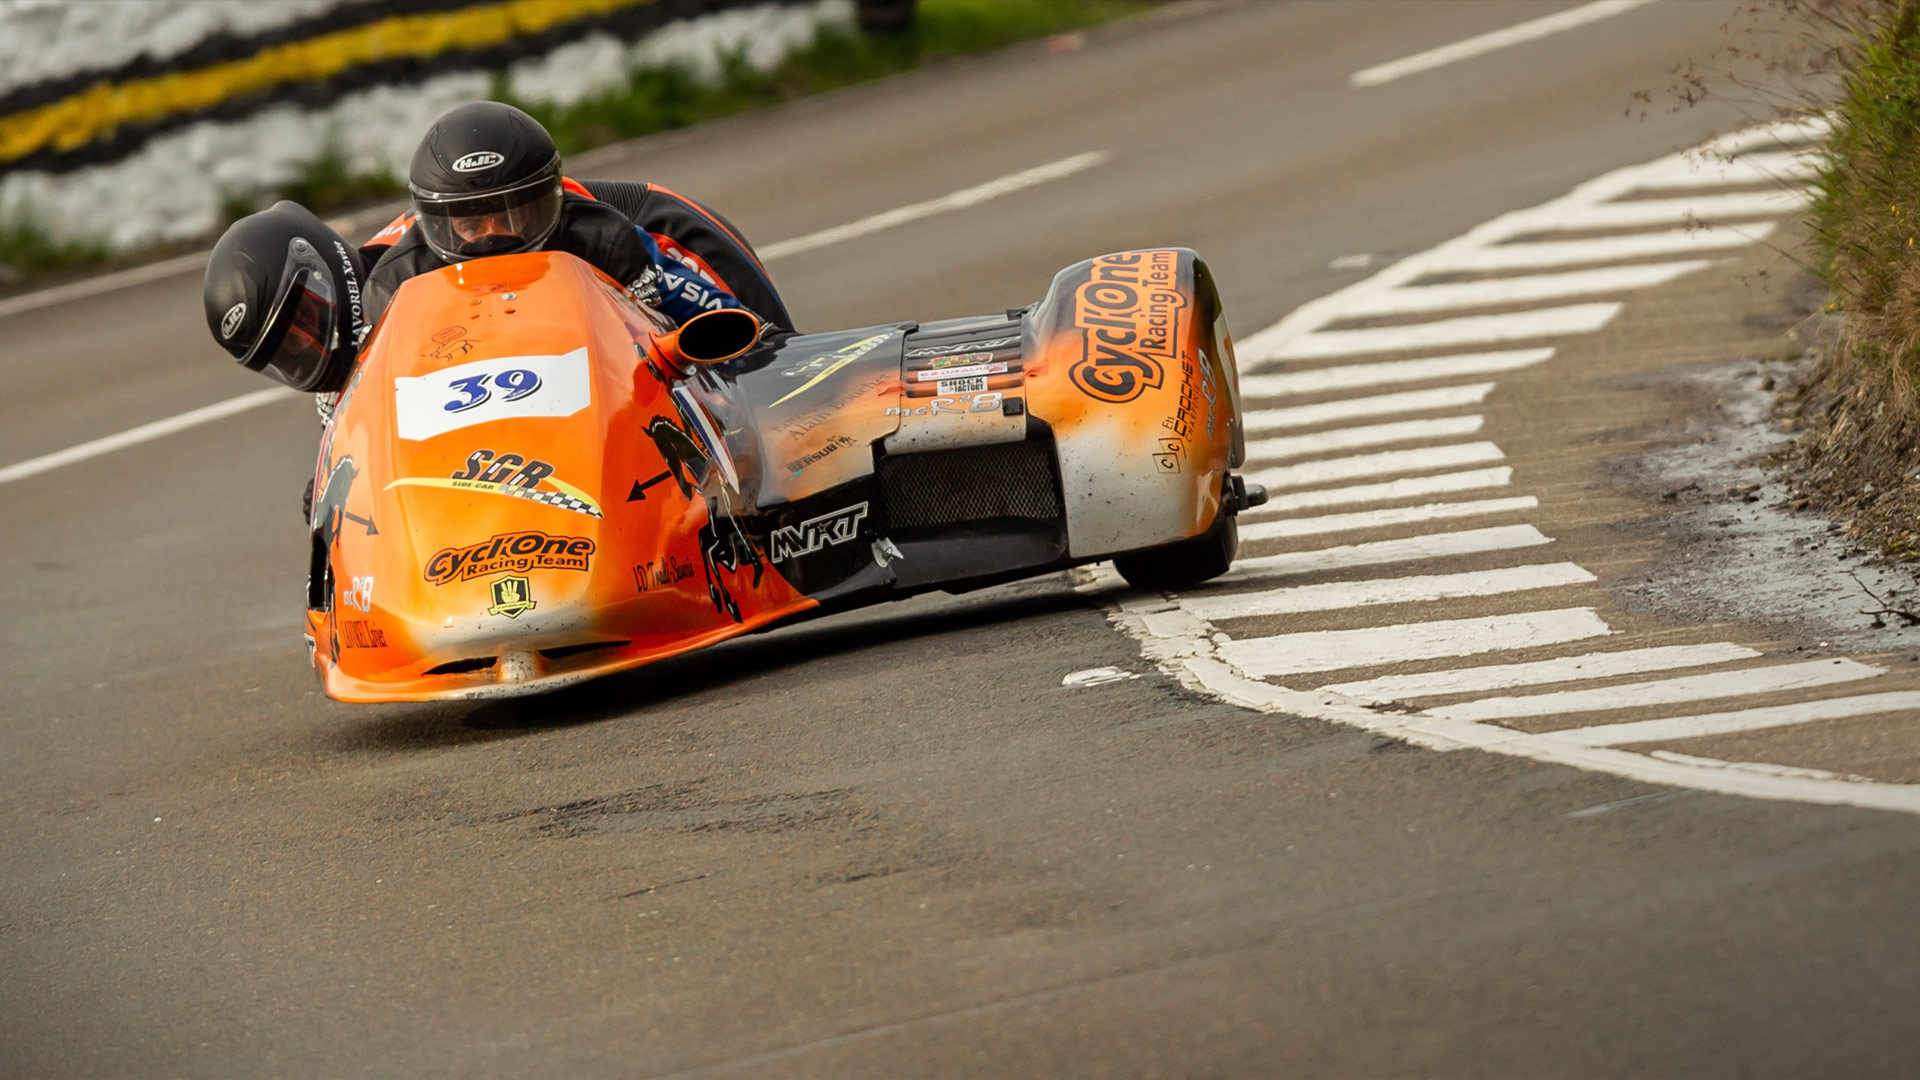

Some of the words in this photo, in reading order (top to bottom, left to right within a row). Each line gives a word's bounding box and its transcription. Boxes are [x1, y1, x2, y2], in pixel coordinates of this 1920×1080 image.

[460, 154, 496, 169] HJC
[1142, 252, 1171, 287] Team
[1140, 293, 1177, 350] Racing
[443, 369, 542, 413] 39
[941, 377, 984, 387] SHOCK
[954, 384, 984, 393] FACTORY
[451, 450, 554, 488] SGR
[452, 480, 494, 490] SIDE-CAR
[467, 556, 529, 576] Racing
[535, 554, 584, 567] Team
